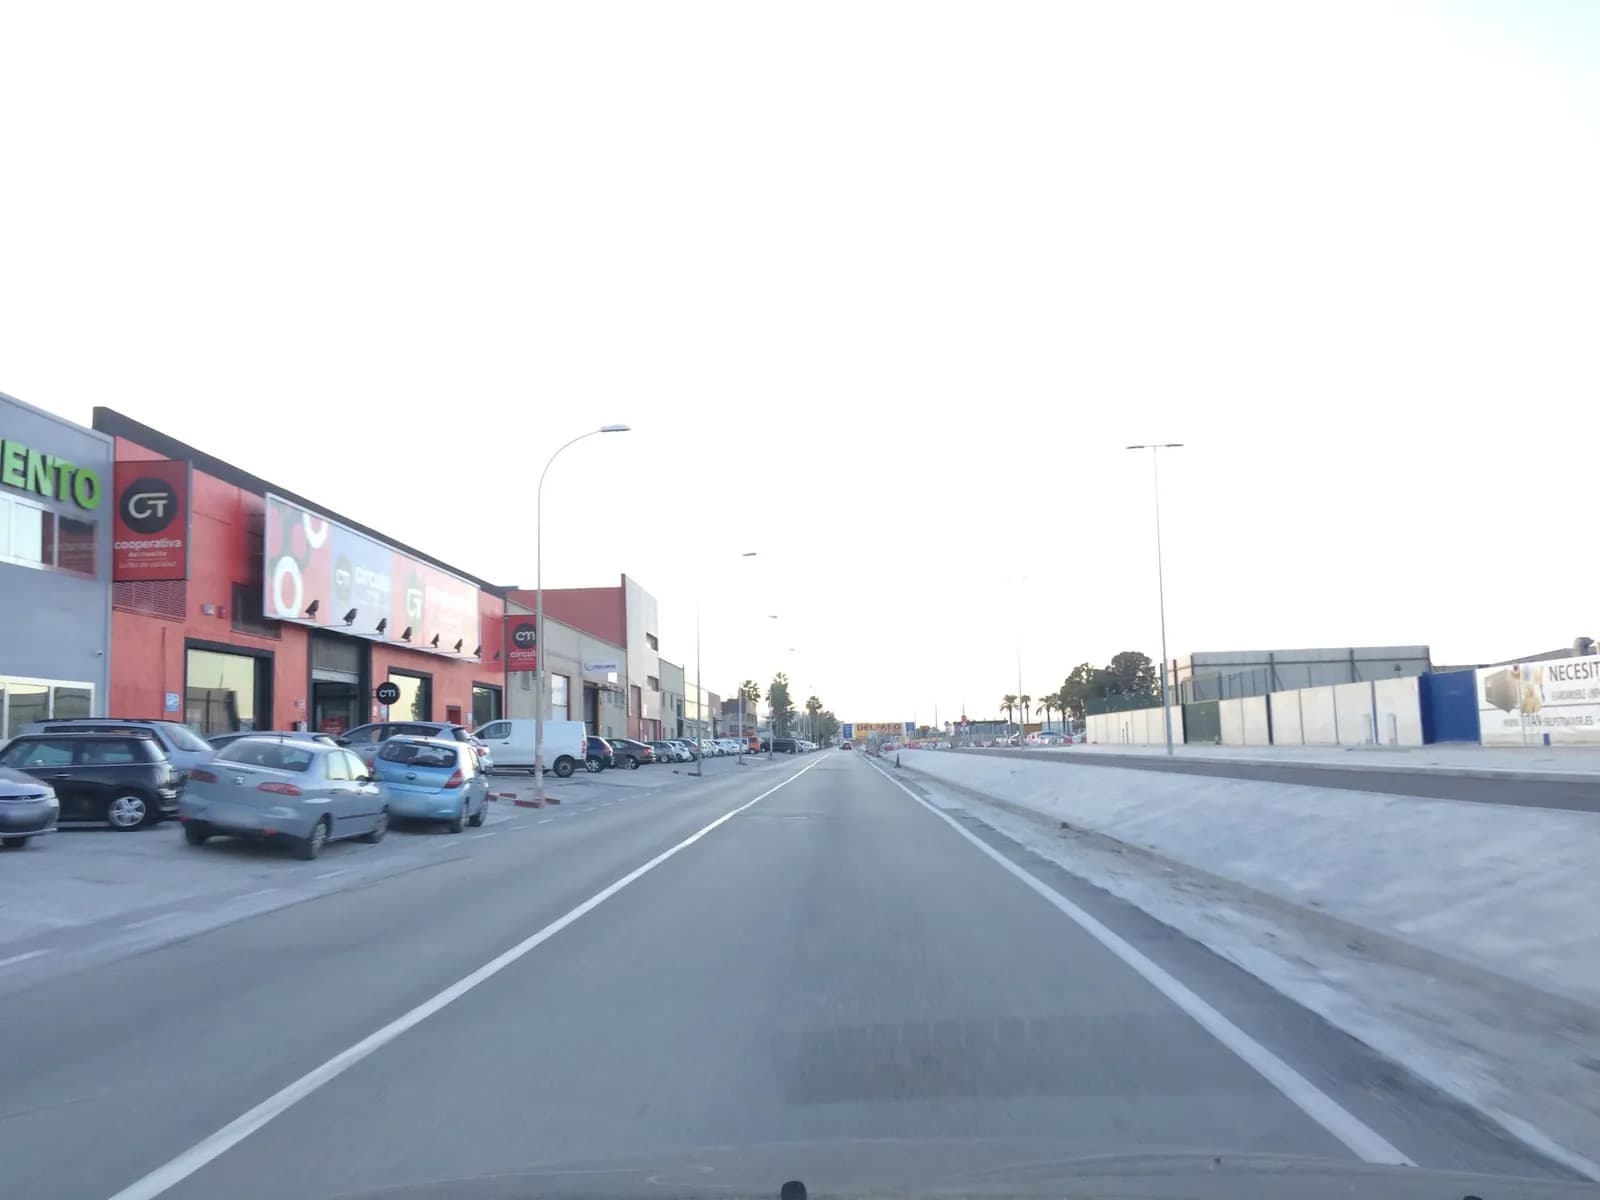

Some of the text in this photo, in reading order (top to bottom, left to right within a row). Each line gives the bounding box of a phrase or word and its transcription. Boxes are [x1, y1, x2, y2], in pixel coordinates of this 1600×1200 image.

[114, 538, 182, 551] cooperativa
[510, 649, 536, 658] circul
[379, 688, 396, 697] cm
